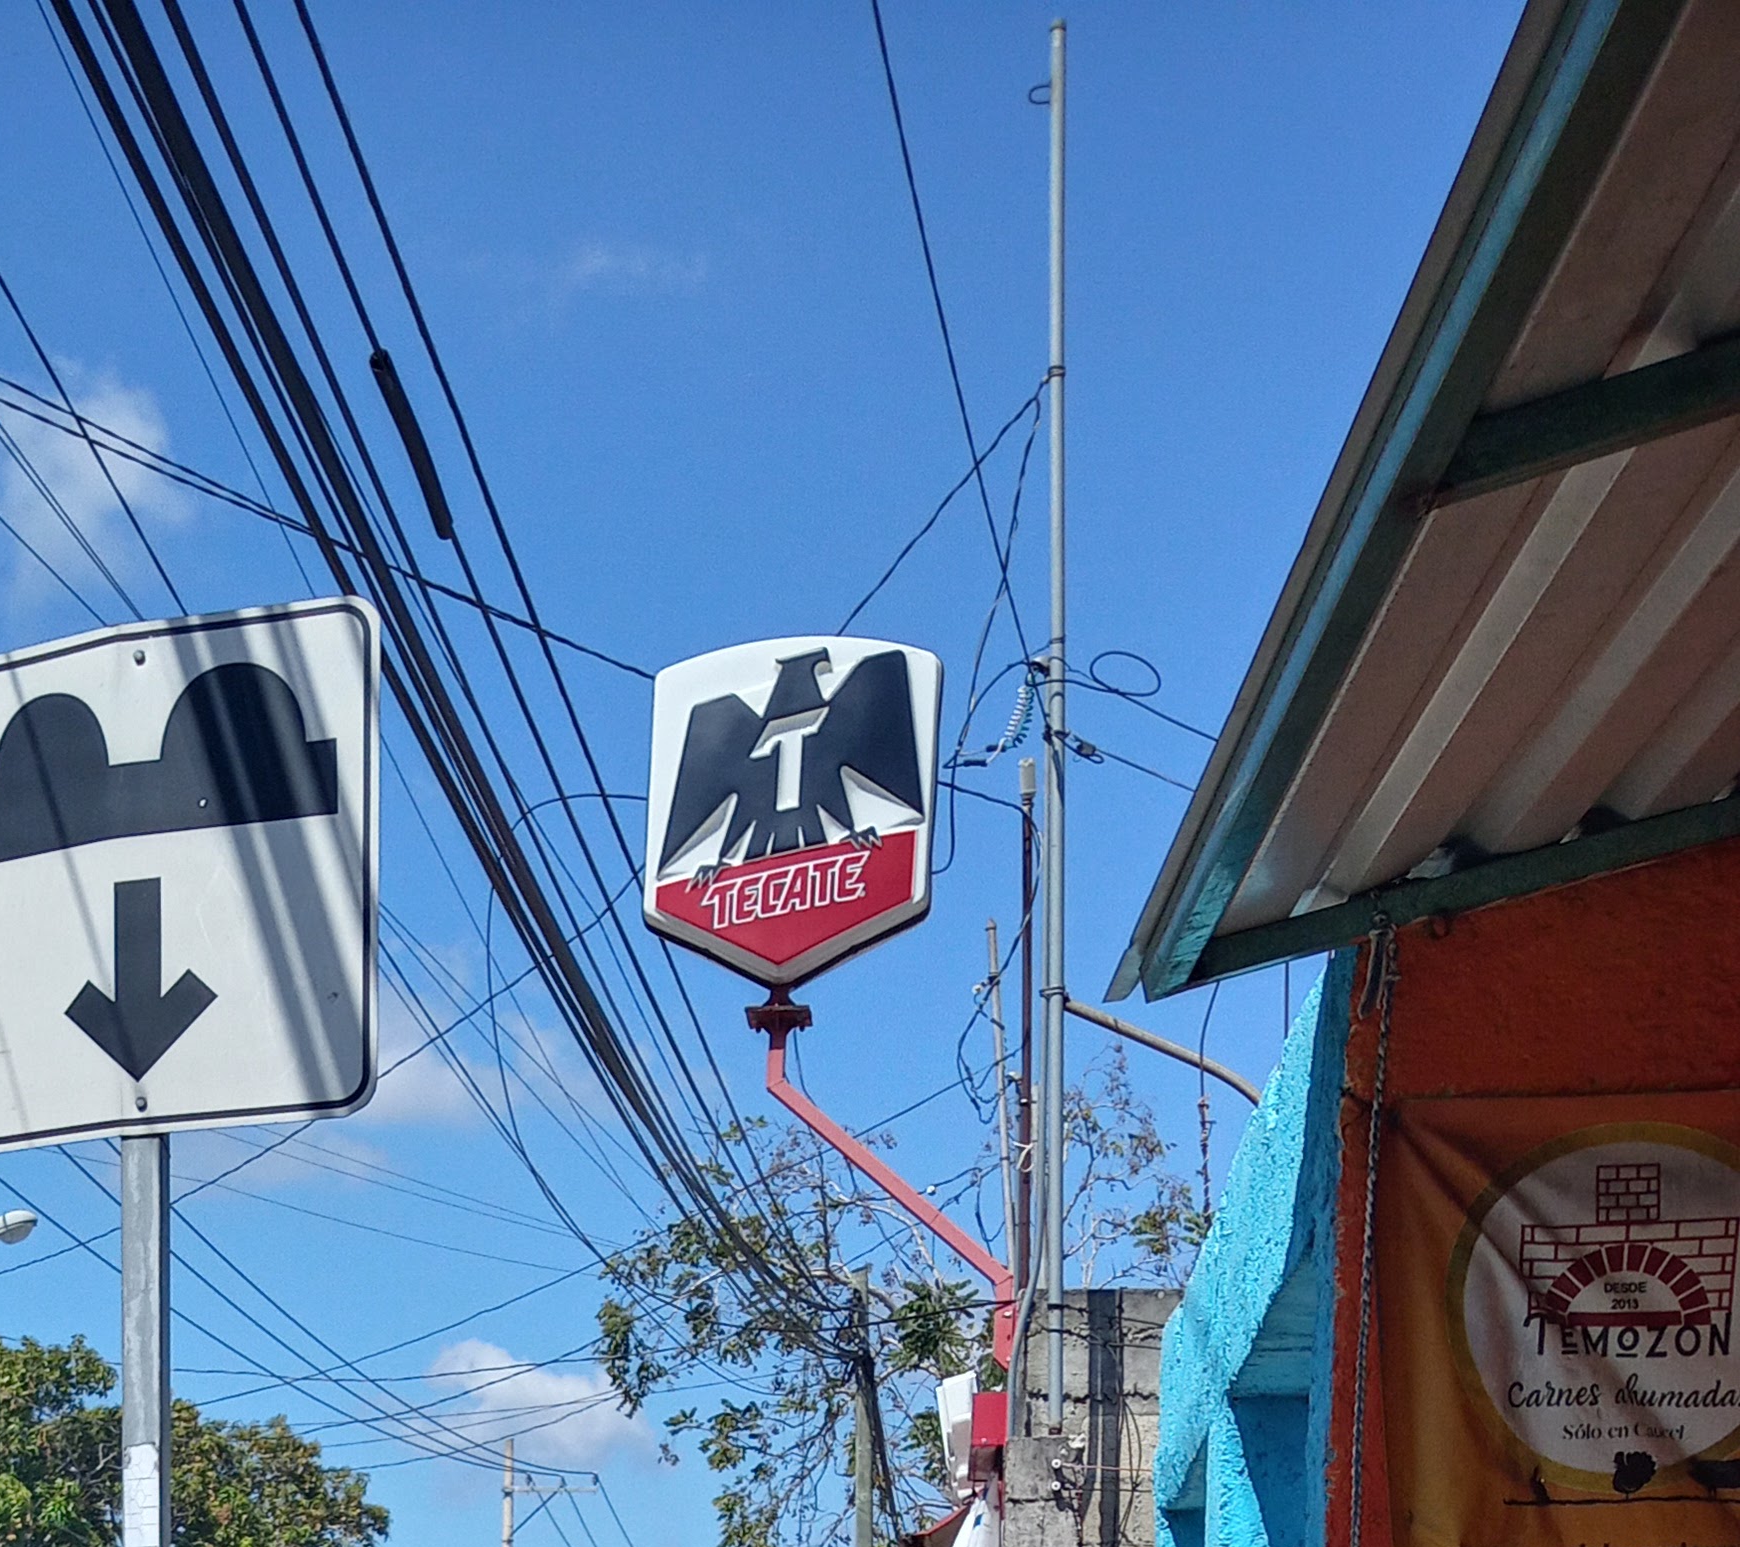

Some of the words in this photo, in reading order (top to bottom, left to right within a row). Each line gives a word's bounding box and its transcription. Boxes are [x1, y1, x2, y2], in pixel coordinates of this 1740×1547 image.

[701, 850, 872, 930] TECATE
[1604, 1281, 1647, 1294] DESDE
[1611, 1298, 1639, 1310] 2013
[1508, 1380, 1601, 1408] Carnes
[1615, 1373, 1740, 1408] ahumada
[1563, 1423, 1602, 1440] Sólo
[1608, 1424, 1629, 1439] en
